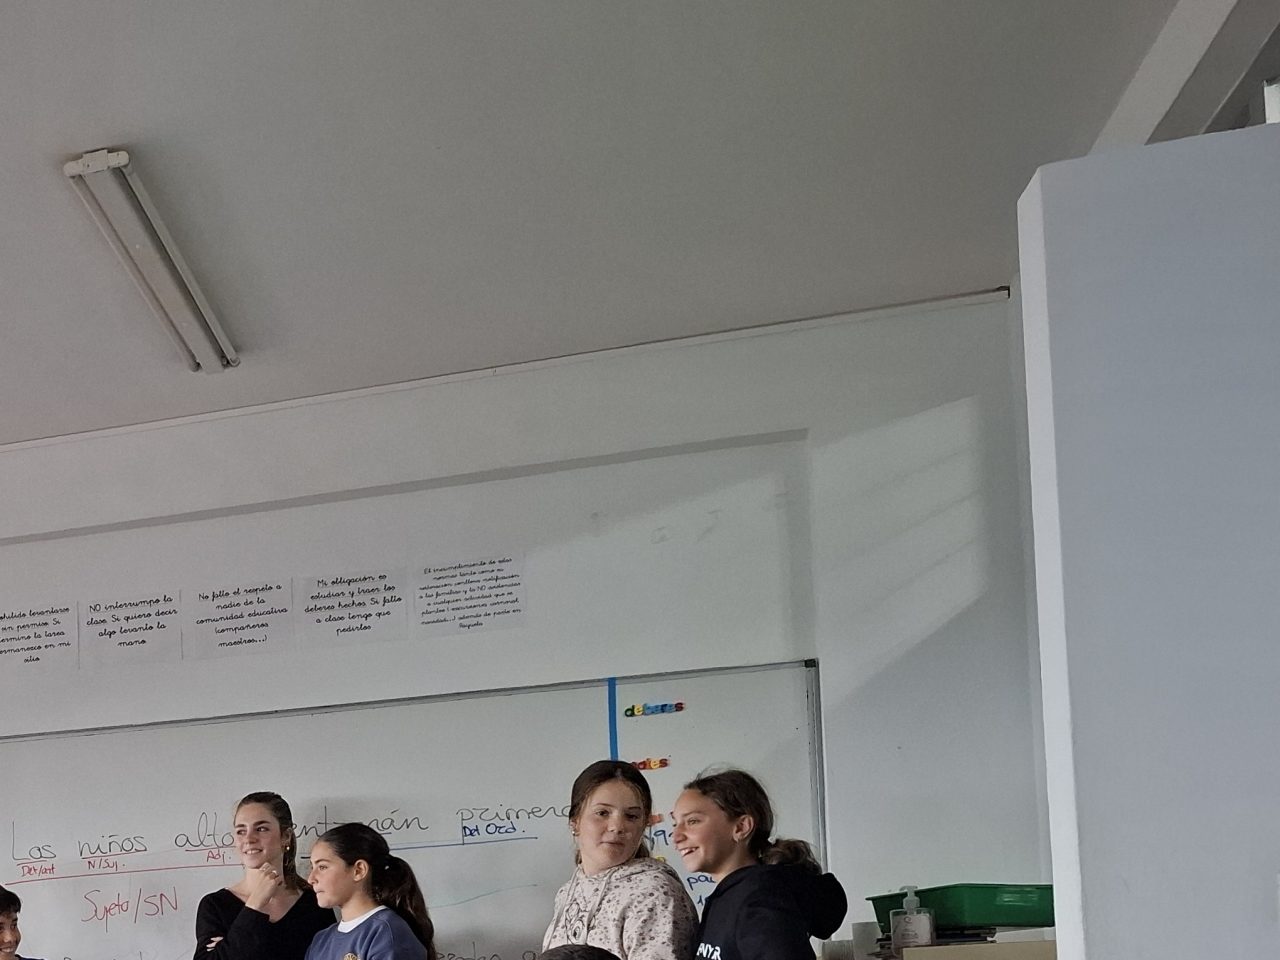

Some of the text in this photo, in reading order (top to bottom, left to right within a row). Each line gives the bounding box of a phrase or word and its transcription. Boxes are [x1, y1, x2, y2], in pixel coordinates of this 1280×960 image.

[198, 592, 209, 600] No
[244, 584, 273, 595] respeto
[310, 592, 345, 600] estudiar
[89, 604, 101, 612] NO
[105, 598, 161, 611] interrumpo
[216, 602, 241, 610] nadie
[124, 613, 152, 623] quiero
[155, 609, 178, 617] decir
[196, 613, 244, 624] comunidad
[34, 631, 42, 639] la
[98, 621, 166, 638] algo levanto la
[118, 639, 146, 647] mano
[77, 834, 148, 857] niños
[174, 812, 235, 848] alto
